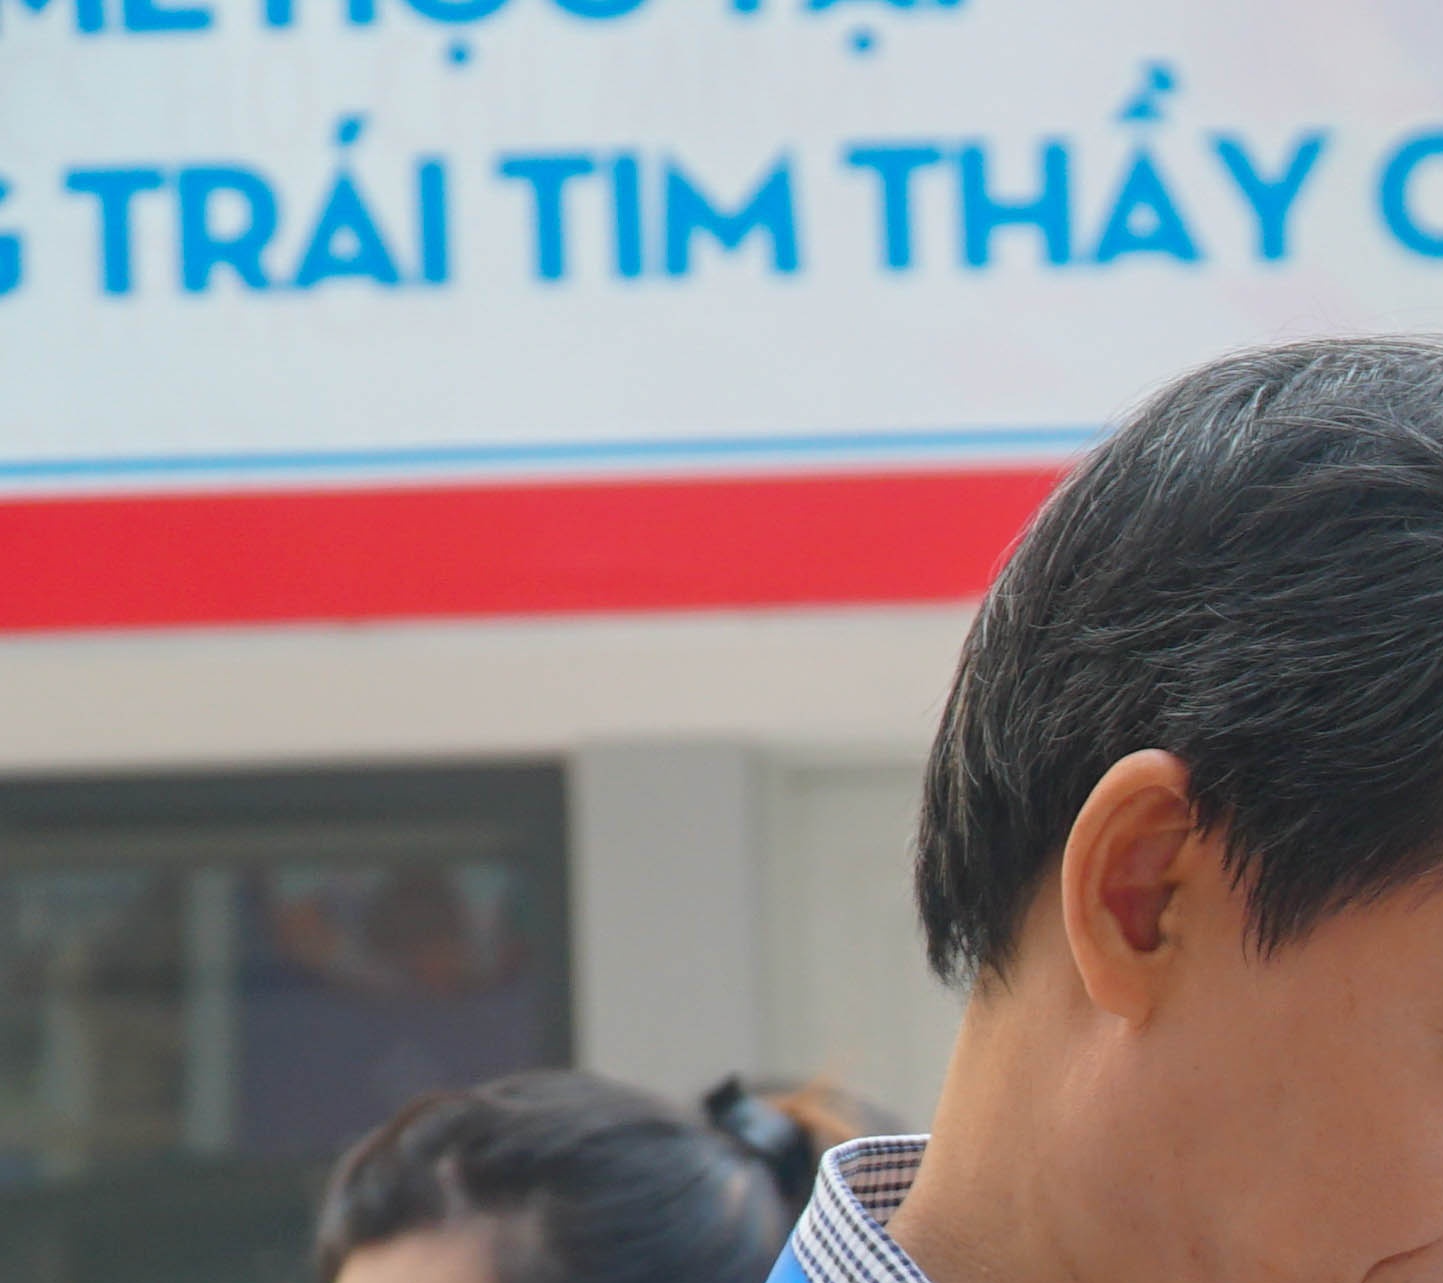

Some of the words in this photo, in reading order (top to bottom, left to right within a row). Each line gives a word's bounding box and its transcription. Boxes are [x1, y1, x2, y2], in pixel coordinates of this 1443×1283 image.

[60, 113, 453, 299] TRÁI
[493, 149, 803, 285] TIM
[841, 63, 1328, 274] THẦY
